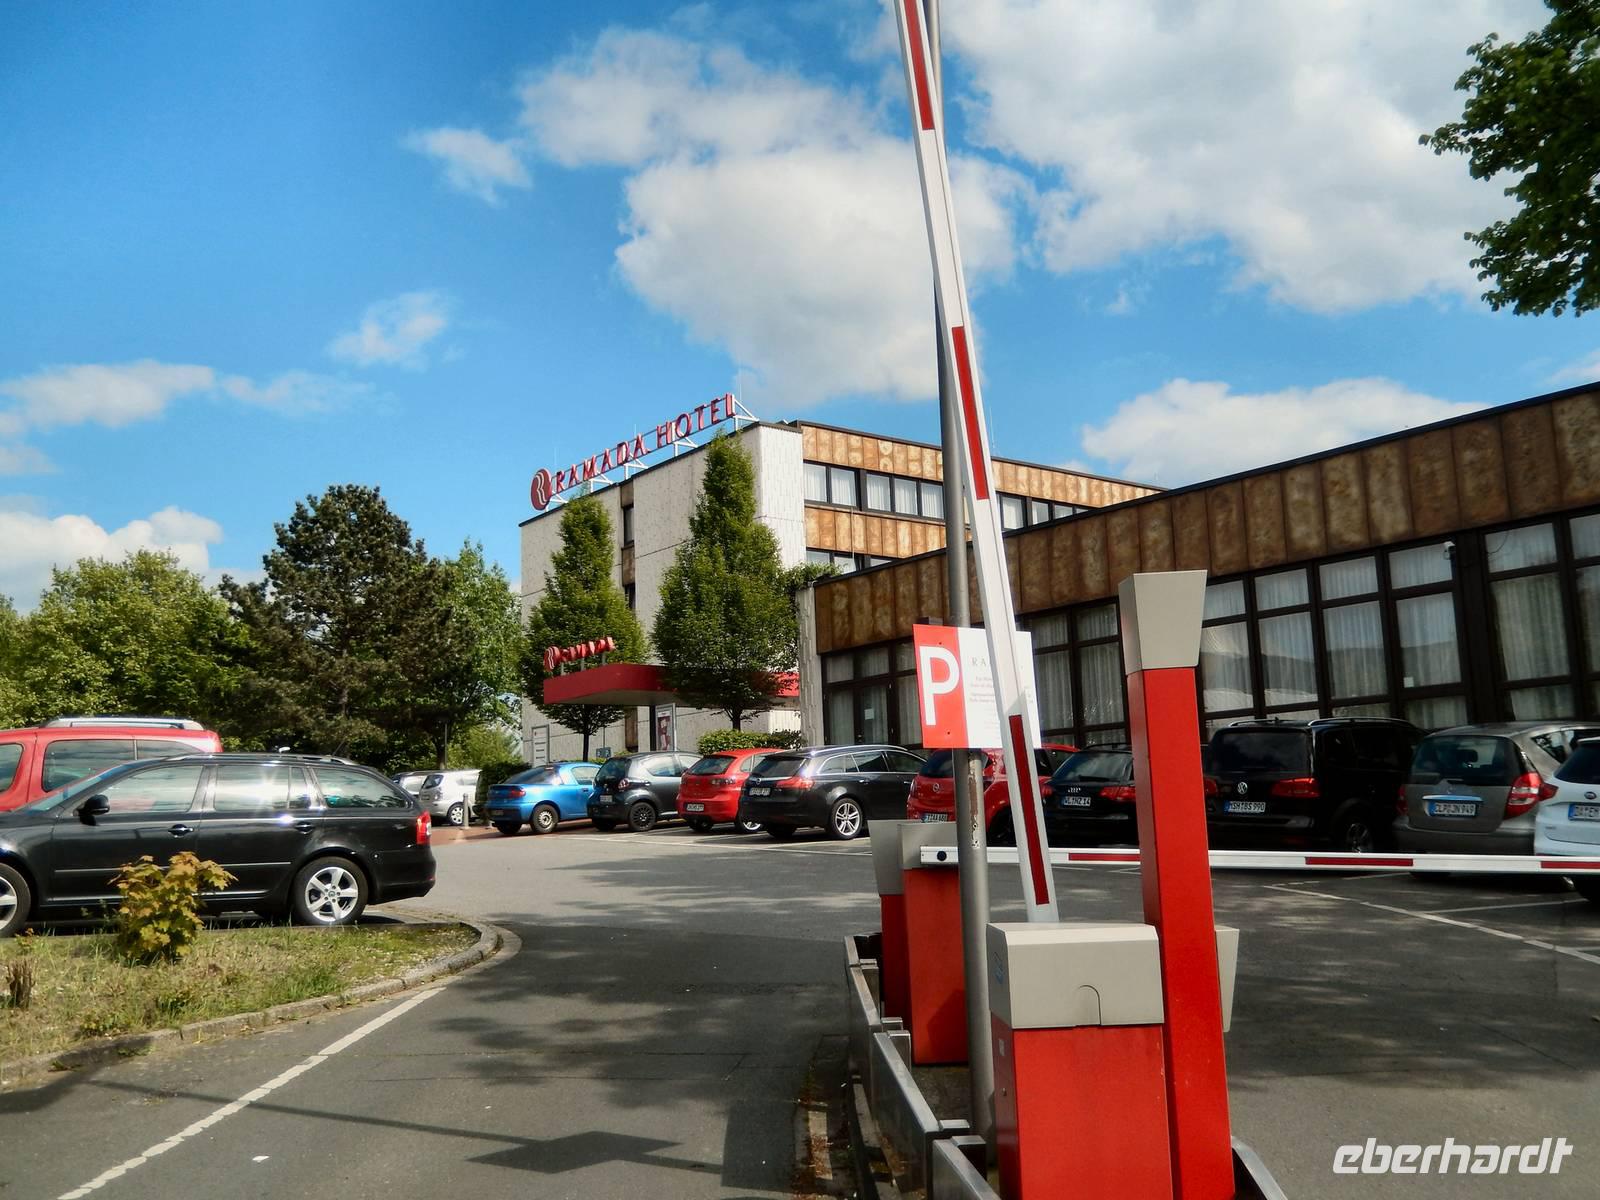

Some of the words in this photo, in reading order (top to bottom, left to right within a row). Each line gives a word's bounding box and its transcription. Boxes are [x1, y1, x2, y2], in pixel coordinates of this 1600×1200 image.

[556, 433, 650, 494] RAMADA
[656, 393, 736, 448] HOTEL
[920, 645, 960, 726] P
